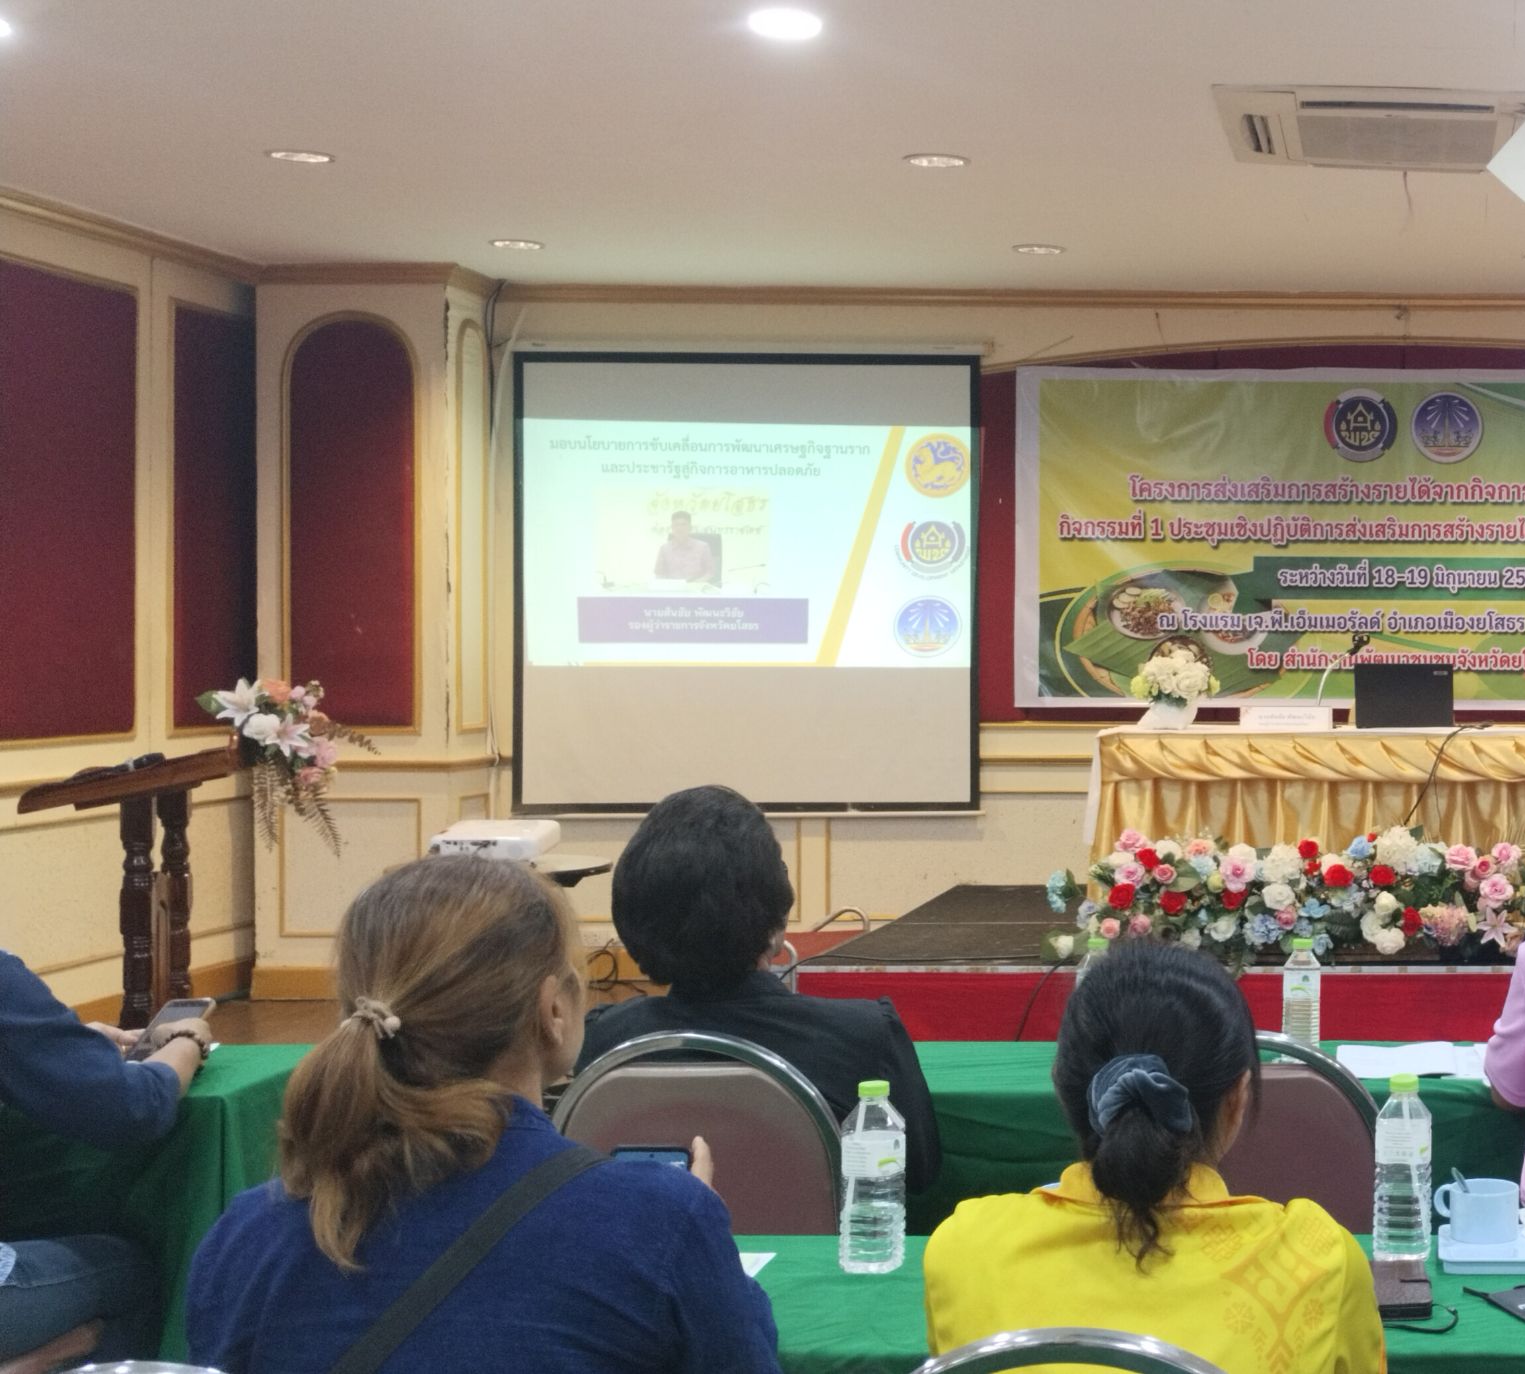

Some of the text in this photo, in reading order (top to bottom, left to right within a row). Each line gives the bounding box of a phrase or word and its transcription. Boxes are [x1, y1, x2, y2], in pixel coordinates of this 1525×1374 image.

[1059, 511, 1143, 538] กิจกรรมที่
[1151, 517, 1163, 537] 1
[1279, 561, 1368, 587] ระหว่างวันที่
[1374, 567, 1429, 586] 18-19
[1434, 566, 1498, 592] มิถุนายน
[1159, 613, 1176, 630] ณ
[1182, 609, 1242, 630] โรงแรม
[1247, 610, 1383, 631] เจ.พี.เอ็มเมอรัลด์
[1388, 611, 1525, 632] อำเภอเมืองยโสธร
[1247, 648, 1279, 668] โดย
